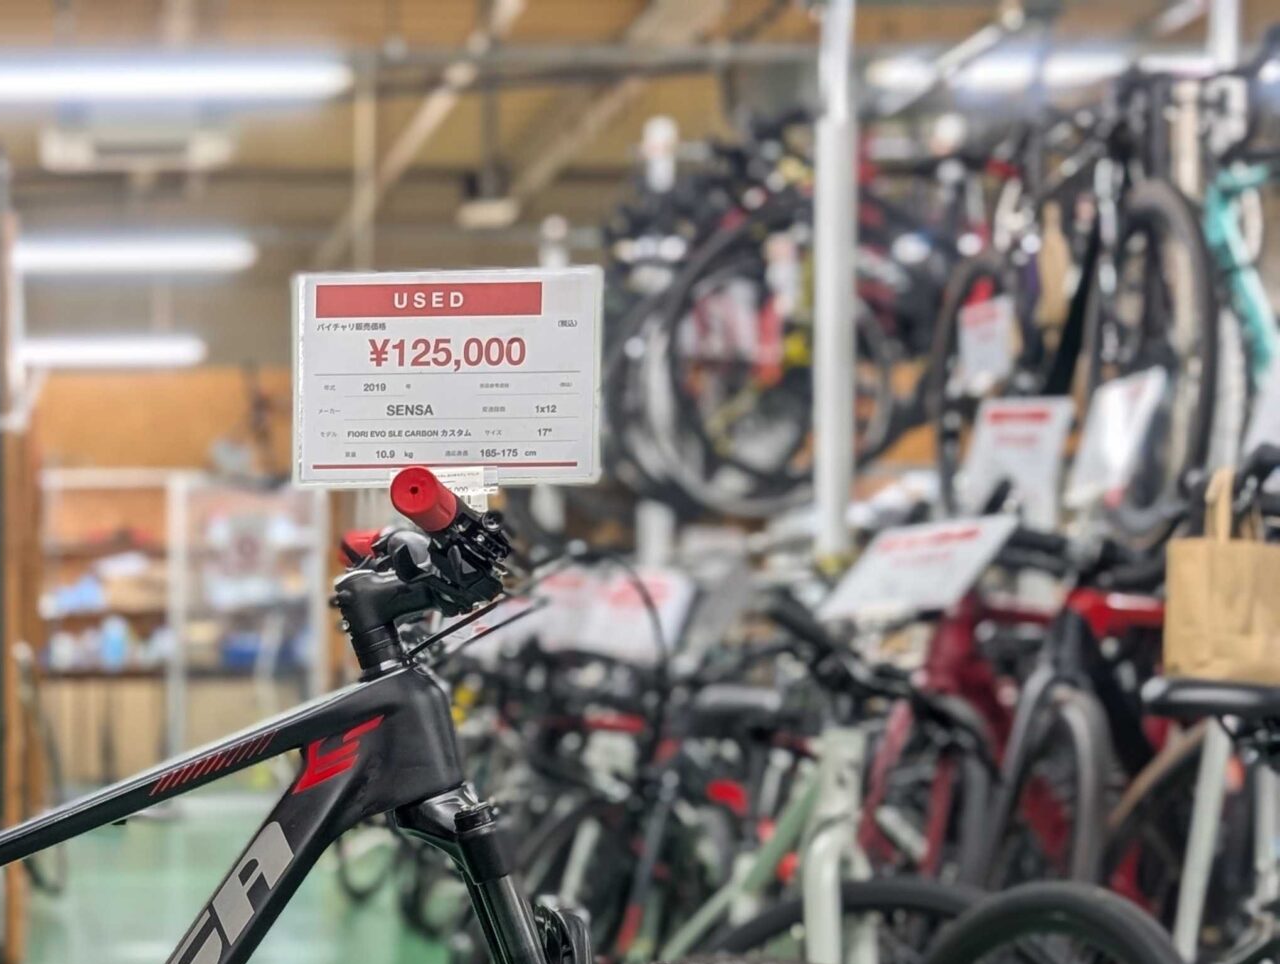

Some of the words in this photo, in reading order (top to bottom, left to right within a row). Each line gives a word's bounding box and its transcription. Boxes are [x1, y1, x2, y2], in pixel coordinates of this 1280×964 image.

[393, 291, 464, 309] USED
[368, 337, 526, 372] ¥125,000
[386, 404, 434, 416] SENSA
[535, 404, 557, 414] 1x12
[347, 430, 369, 438] FIORI
[370, 430, 386, 438] EVO
[387, 429, 403, 438] SLE
[404, 428, 439, 438] CARBON
[440, 428, 472, 438] カスタム
[375, 450, 396, 459] 10.9
[404, 450, 414, 459] kg
[479, 447, 518, 458] 165-175
